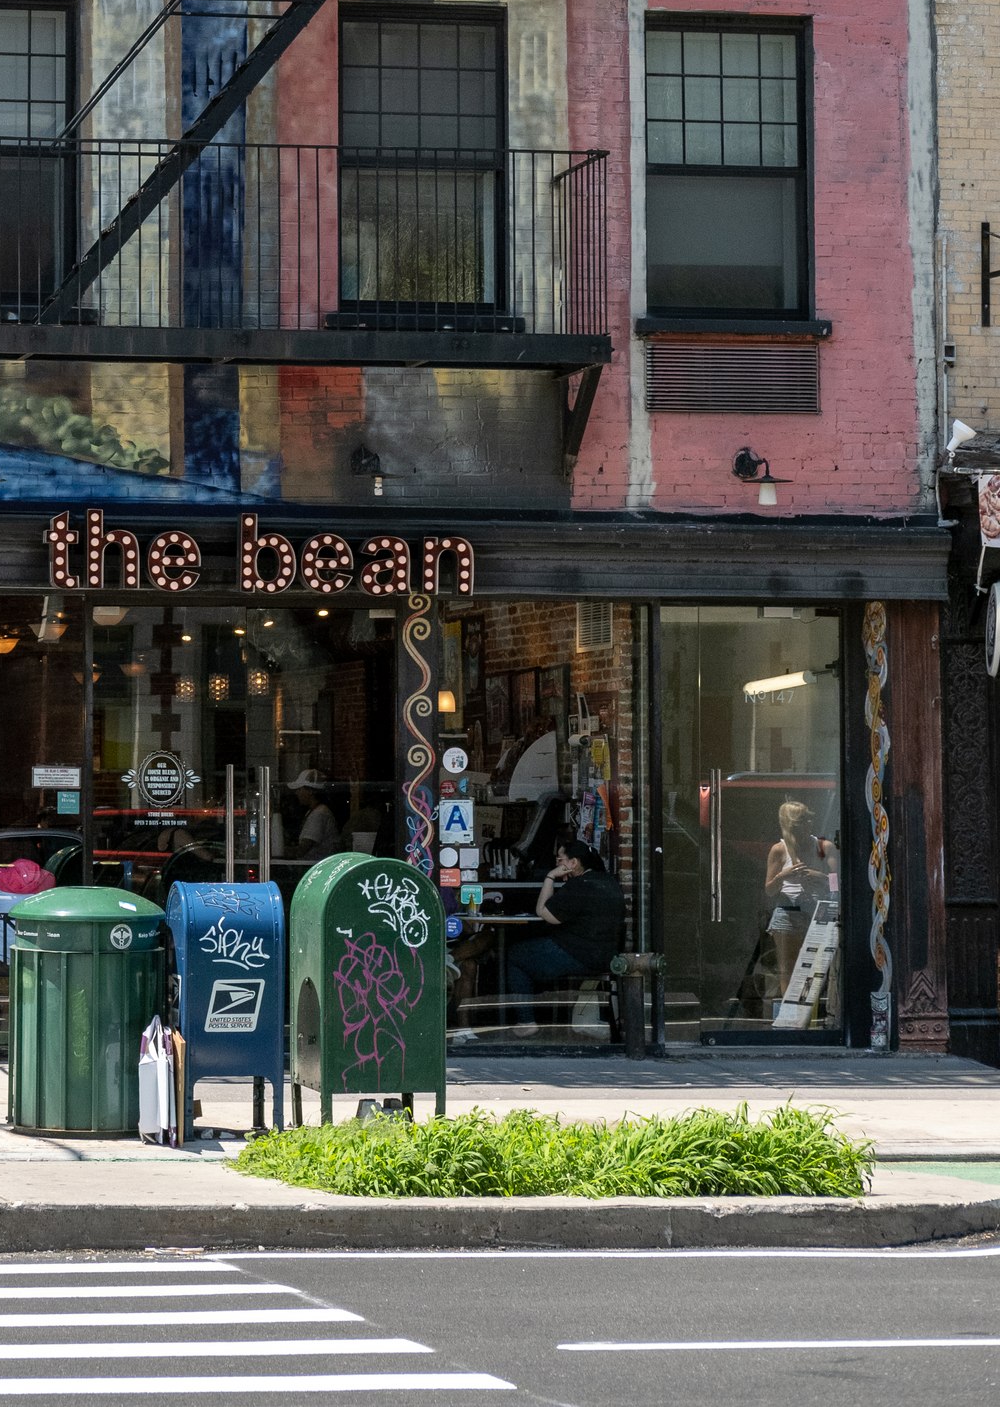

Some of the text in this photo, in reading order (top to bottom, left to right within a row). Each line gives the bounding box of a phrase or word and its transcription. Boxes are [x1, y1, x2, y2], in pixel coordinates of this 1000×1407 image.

[43, 508, 474, 596] the bean
[772, 690, 795, 704] 147
[445, 805, 467, 831] A
